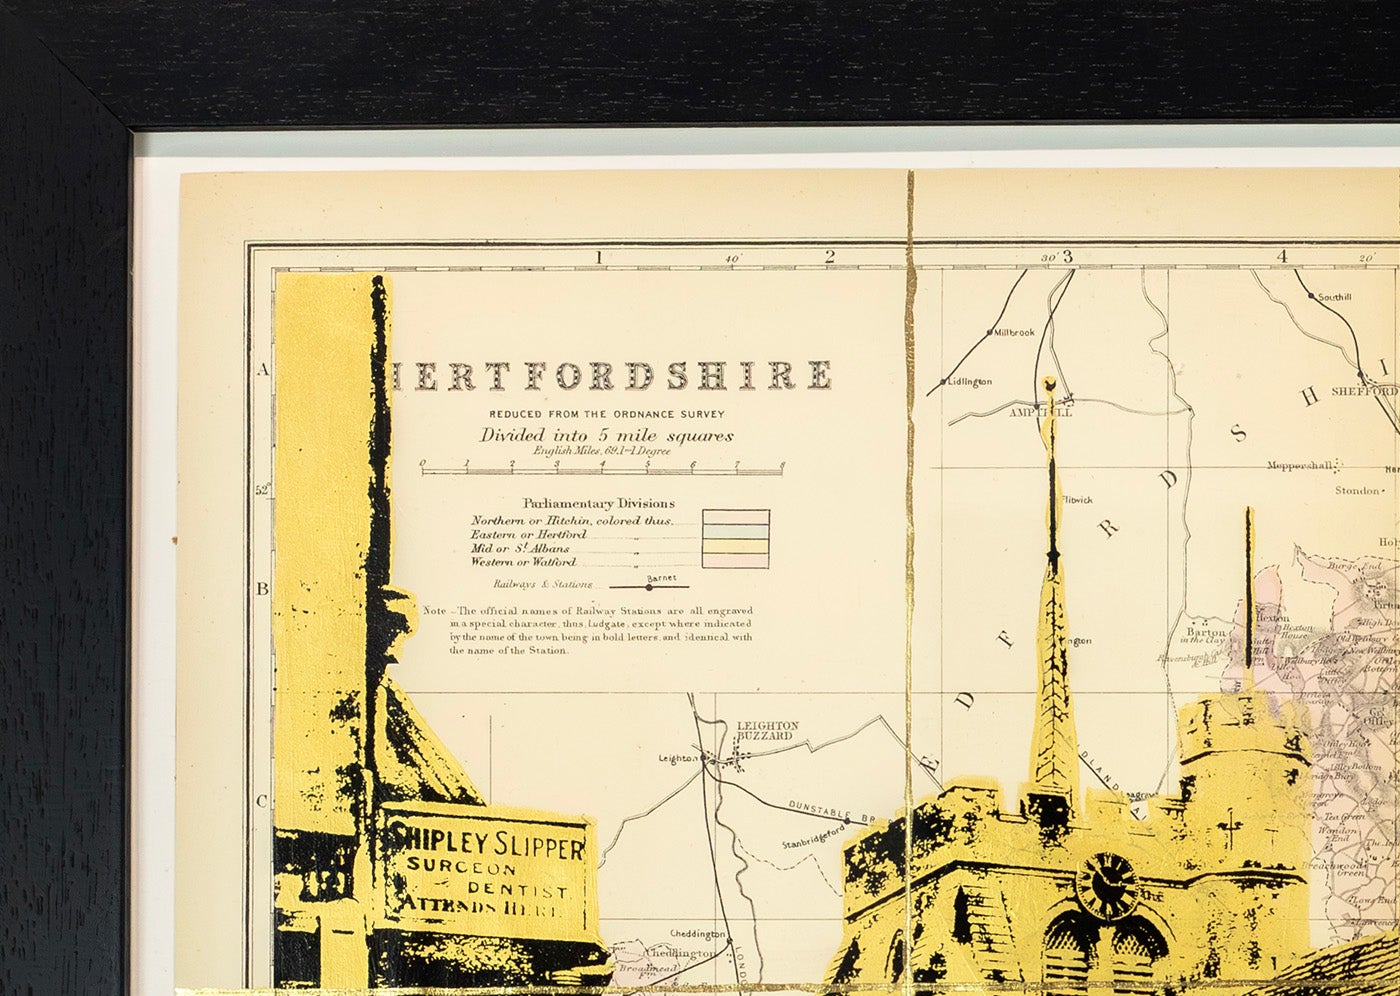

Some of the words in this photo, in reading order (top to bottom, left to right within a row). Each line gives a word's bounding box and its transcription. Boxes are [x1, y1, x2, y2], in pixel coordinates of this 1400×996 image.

[596, 250, 603, 265] 1
[825, 250, 835, 265] 2
[1063, 250, 1073, 264] 3
[1276, 250, 1289, 263] 4
[1318, 292, 1352, 302] Southill
[994, 327, 1036, 338] Millbrook
[947, 376, 993, 389] Lidlington
[1331, 385, 1399, 397] SHEFFORD
[489, 409, 542, 419] REDUCED
[548, 409, 579, 419] FROM
[583, 409, 607, 419] THE
[613, 409, 675, 419] ORDNANCE
[680, 409, 726, 419] SURVEY
[478, 427, 549, 443] Divided
[553, 428, 588, 442] into
[598, 427, 609, 443] 5
[617, 427, 657, 442] mile
[665, 431, 735, 448] squares
[533, 445, 572, 458] English
[1335, 485, 1380, 497] Stondon
[523, 498, 615, 511] Parliamentary
[617, 497, 676, 509] Divisions
[470, 515, 525, 526] Northern
[529, 518, 542, 526] or
[596, 515, 641, 526] colored
[470, 529, 515, 540] Eastern
[520, 532, 534, 540] or
[536, 529, 588, 540] Hertford
[470, 543, 493, 553] Mid
[496, 545, 510, 553] or
[528, 543, 570, 553] Albans
[470, 557, 514, 567] Western
[516, 559, 530, 567] or
[533, 557, 577, 567] Watford
[493, 579, 536, 590] Railways
[554, 579, 593, 589] Stations
[647, 574, 677, 583] Barnet
[422, 606, 447, 616] Note
[480, 606, 518, 616] official
[521, 606, 558, 616] names
[562, 606, 573, 616] of
[576, 606, 616, 618] Railway
[620, 606, 662, 616] Stations
[667, 606, 684, 616] are
[690, 606, 703, 616] all
[707, 606, 754, 618] engraved
[461, 620, 468, 629] a
[469, 619, 507, 631] special
[632, 621, 666, 631] except
[668, 620, 701, 629] where
[703, 620, 752, 629] indicated
[1186, 627, 1226, 637] Barton
[449, 633, 462, 644] by
[462, 633, 477, 642] the
[479, 633, 505, 642] name
[506, 633, 517, 642] of
[518, 633, 533, 642] the
[535, 633, 559, 642] town
[561, 633, 589, 644] being
[591, 633, 601, 642] in
[603, 633, 624, 642] bold
[661, 633, 681, 642] and
[732, 633, 753, 642] with
[449, 646, 465, 655] the
[467, 646, 495, 655] name
[498, 646, 509, 655] of
[510, 646, 526, 655] the
[736, 720, 799, 731] LEIGHTON
[736, 731, 794, 741] BUZZARD
[658, 753, 698, 766] Leighton
[789, 800, 851, 818] DUNSTABLE
[782, 824, 845, 849] Stanbridgeford
[494, 830, 586, 861] SLIPPER
[670, 929, 726, 942] Cheddington
